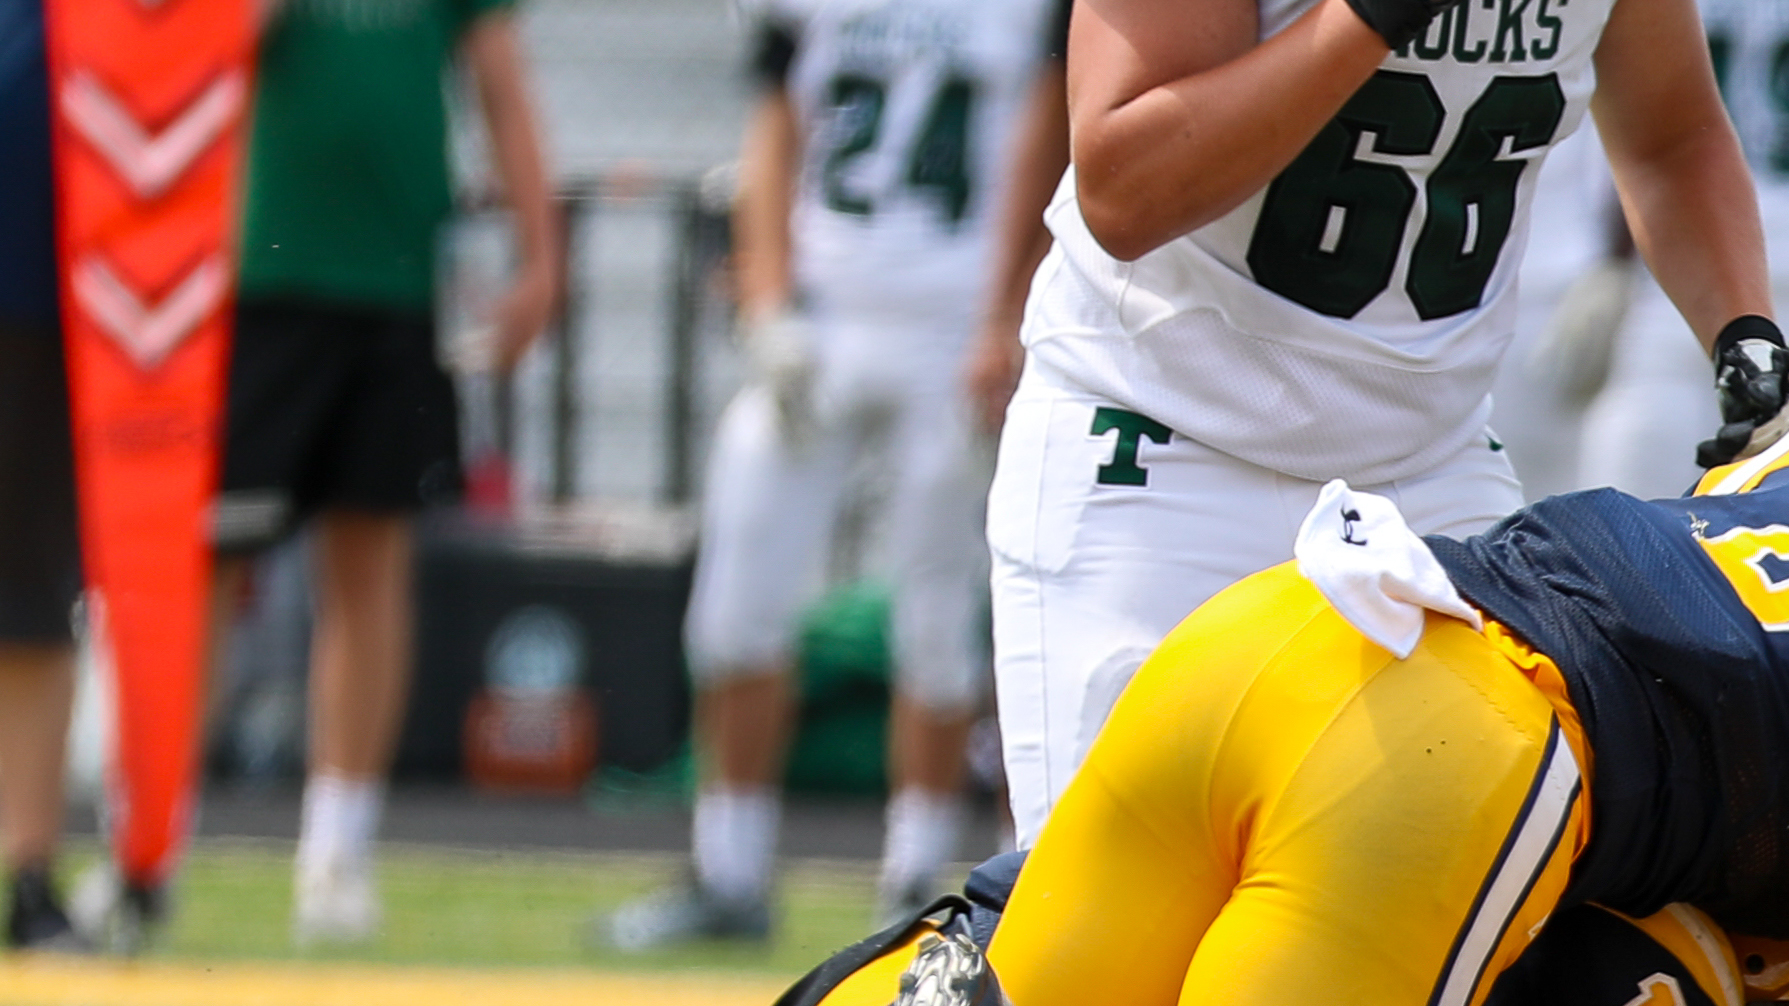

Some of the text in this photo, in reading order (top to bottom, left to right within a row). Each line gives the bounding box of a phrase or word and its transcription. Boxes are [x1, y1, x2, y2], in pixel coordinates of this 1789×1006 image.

[1394, 0, 1569, 64] OCKS
[824, 70, 974, 224] 24
[1246, 69, 1567, 321] 66
[1089, 405, 1175, 488] T
